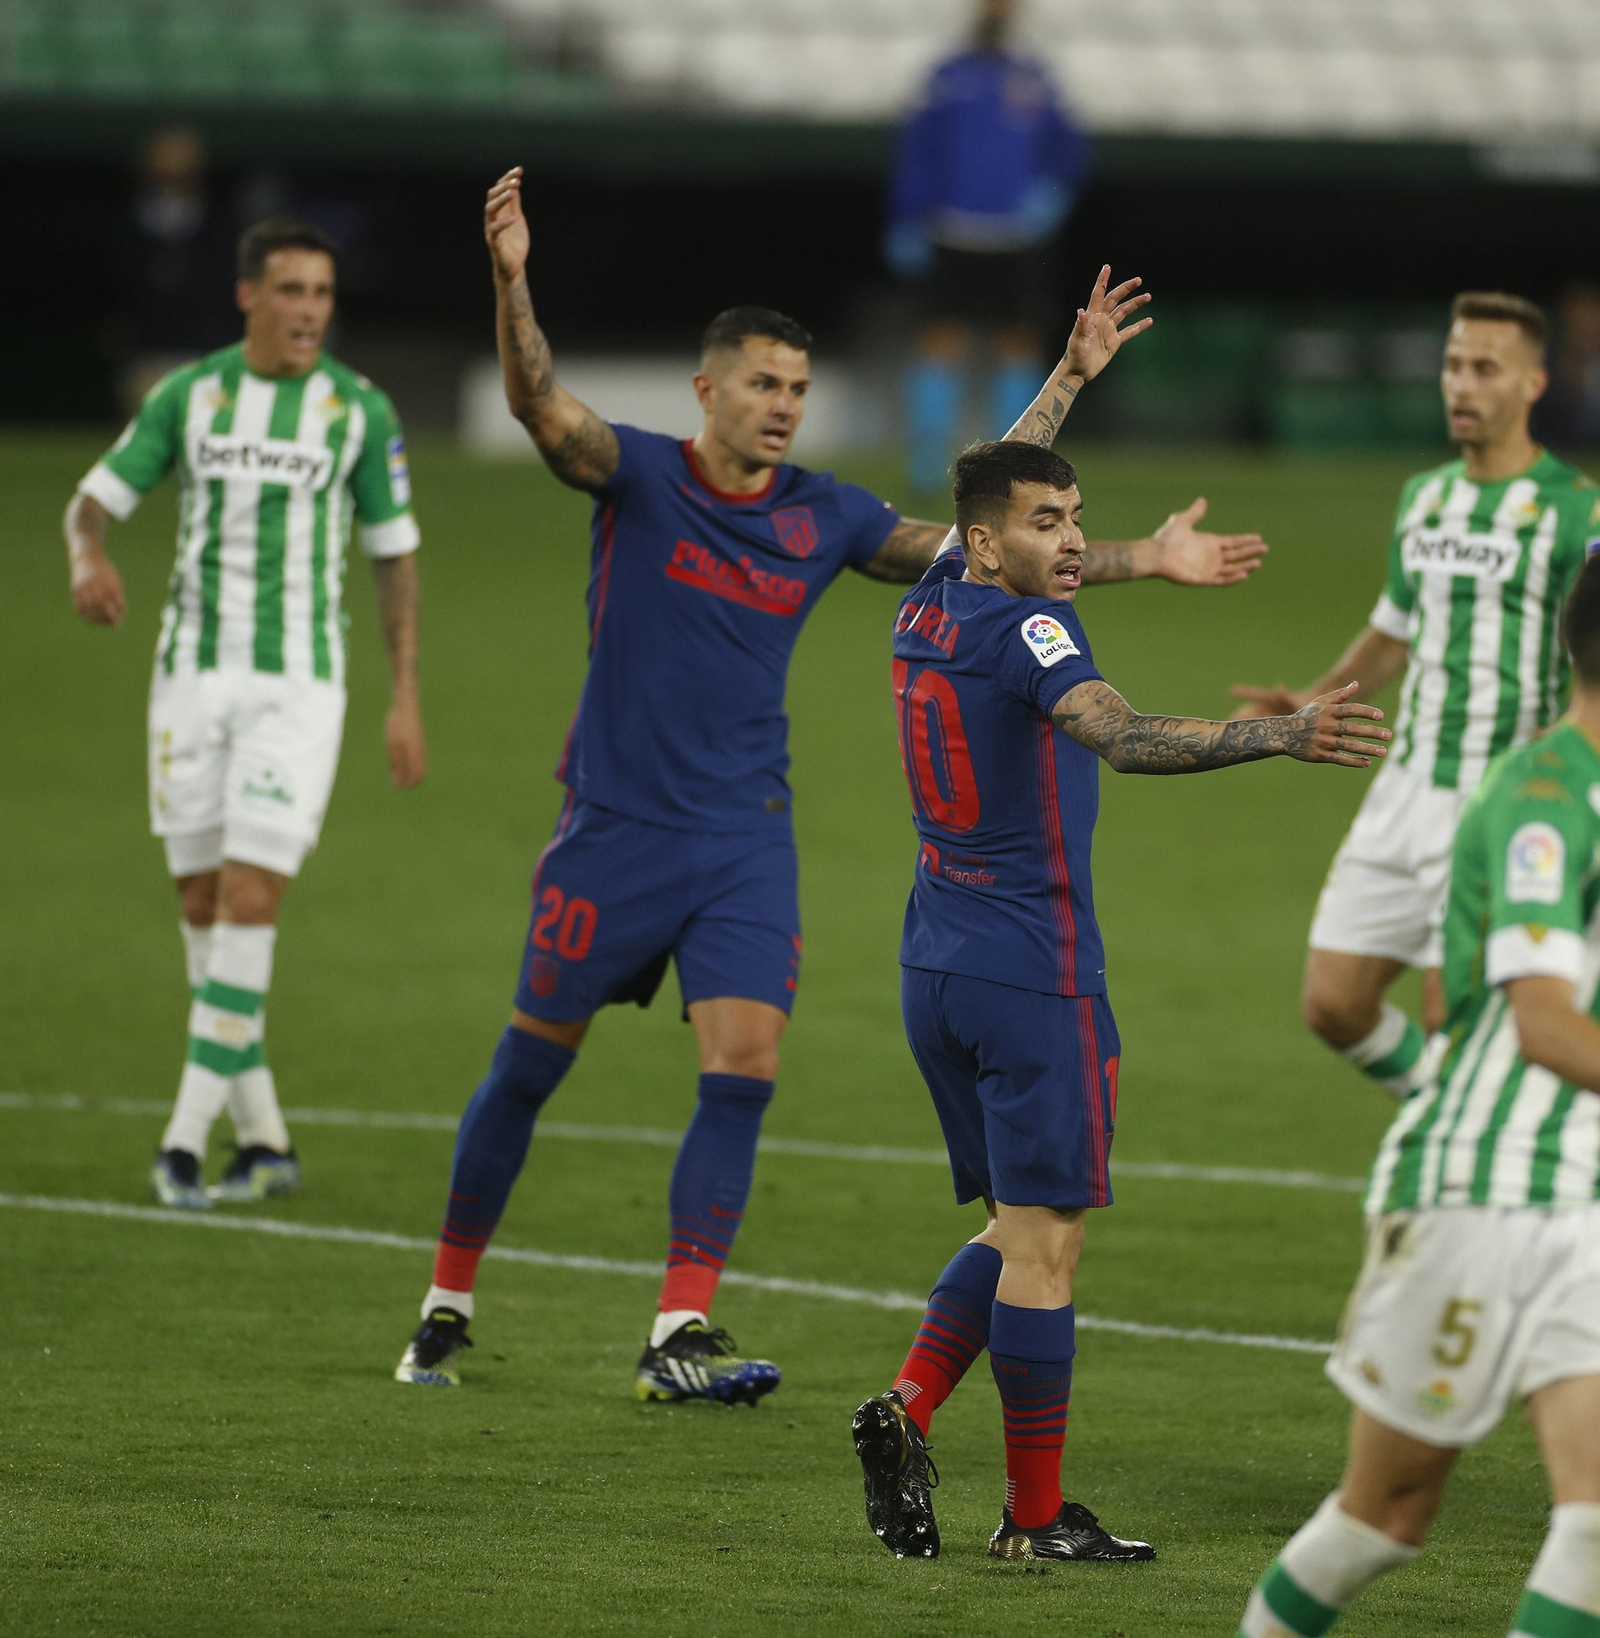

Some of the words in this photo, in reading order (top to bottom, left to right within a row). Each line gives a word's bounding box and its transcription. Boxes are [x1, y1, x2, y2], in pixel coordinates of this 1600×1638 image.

[199, 440, 325, 487] betway
[1040, 642, 1073, 659] LaLiga
[943, 866, 996, 886] Transfer
[531, 885, 598, 961] 20
[1431, 1298, 1484, 1369] 5
